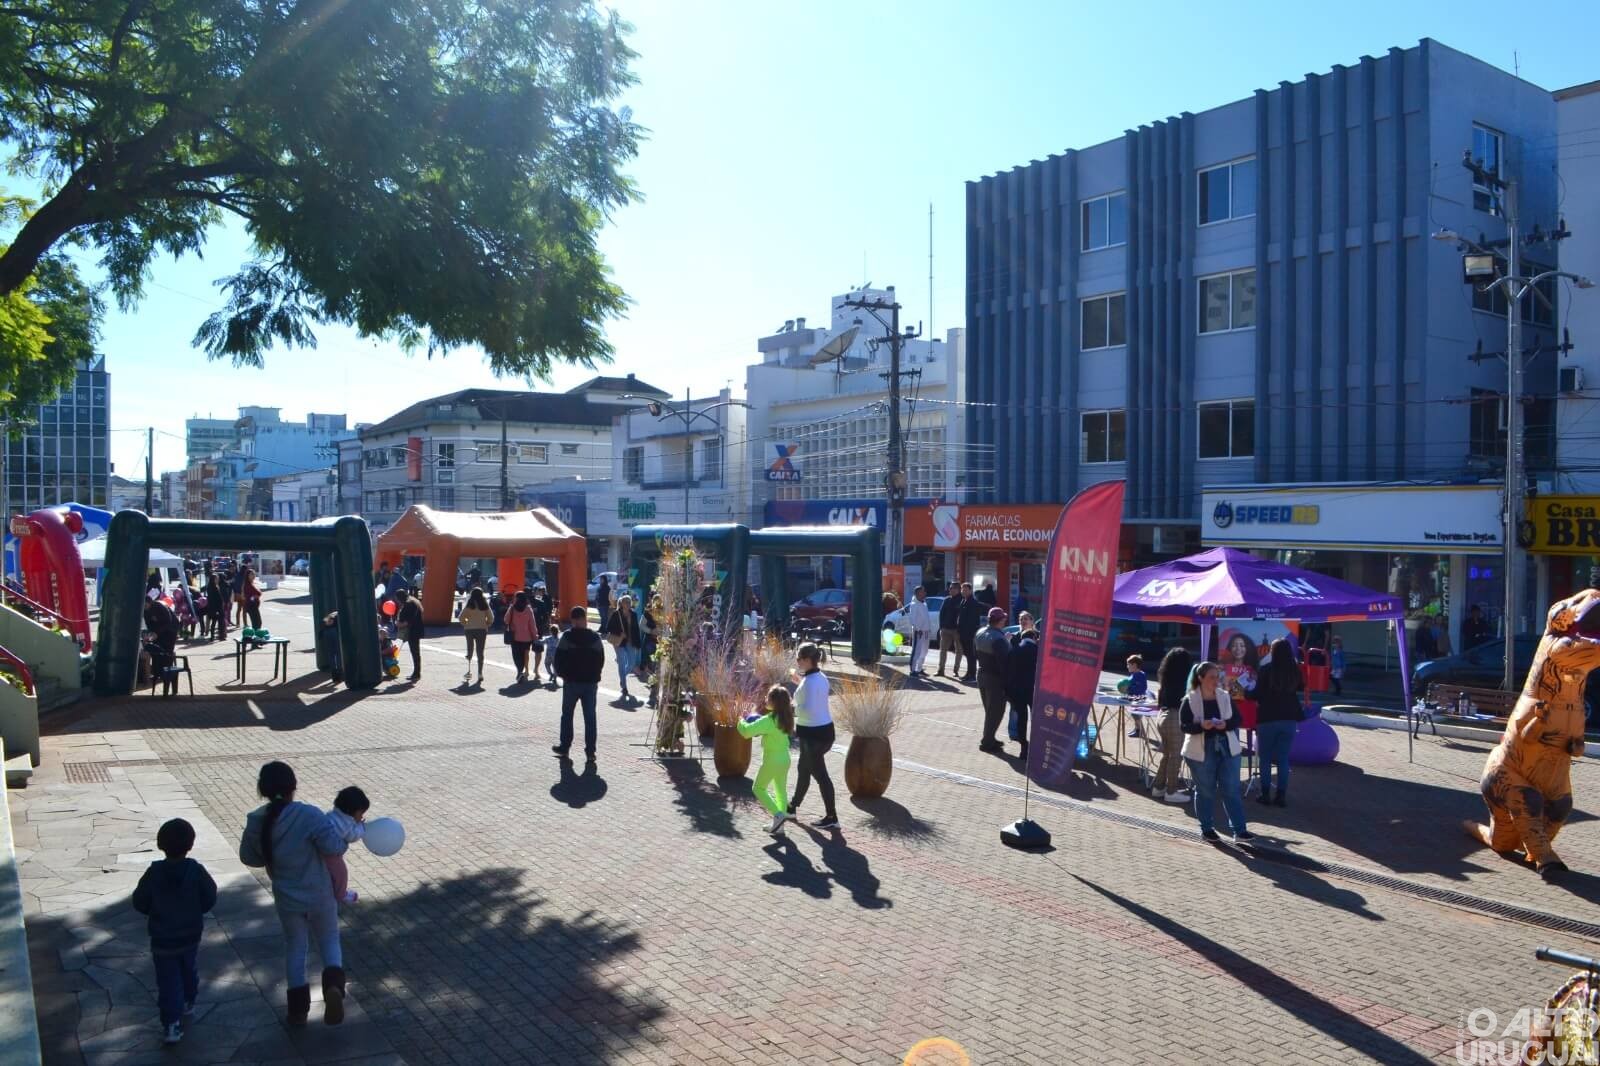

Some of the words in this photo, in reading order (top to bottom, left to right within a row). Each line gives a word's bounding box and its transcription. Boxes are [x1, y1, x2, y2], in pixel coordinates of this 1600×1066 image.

[769, 471, 799, 480] CAIXA
[828, 506, 878, 525] CAIXA
[1547, 503, 1597, 518] Casa
[965, 511, 1021, 527] FARMÁCIAS
[663, 534, 694, 547] SICOOB
[965, 529, 1000, 541] SANTA
[1060, 545, 1109, 577] KNN
[1256, 578, 1320, 595] KNN
